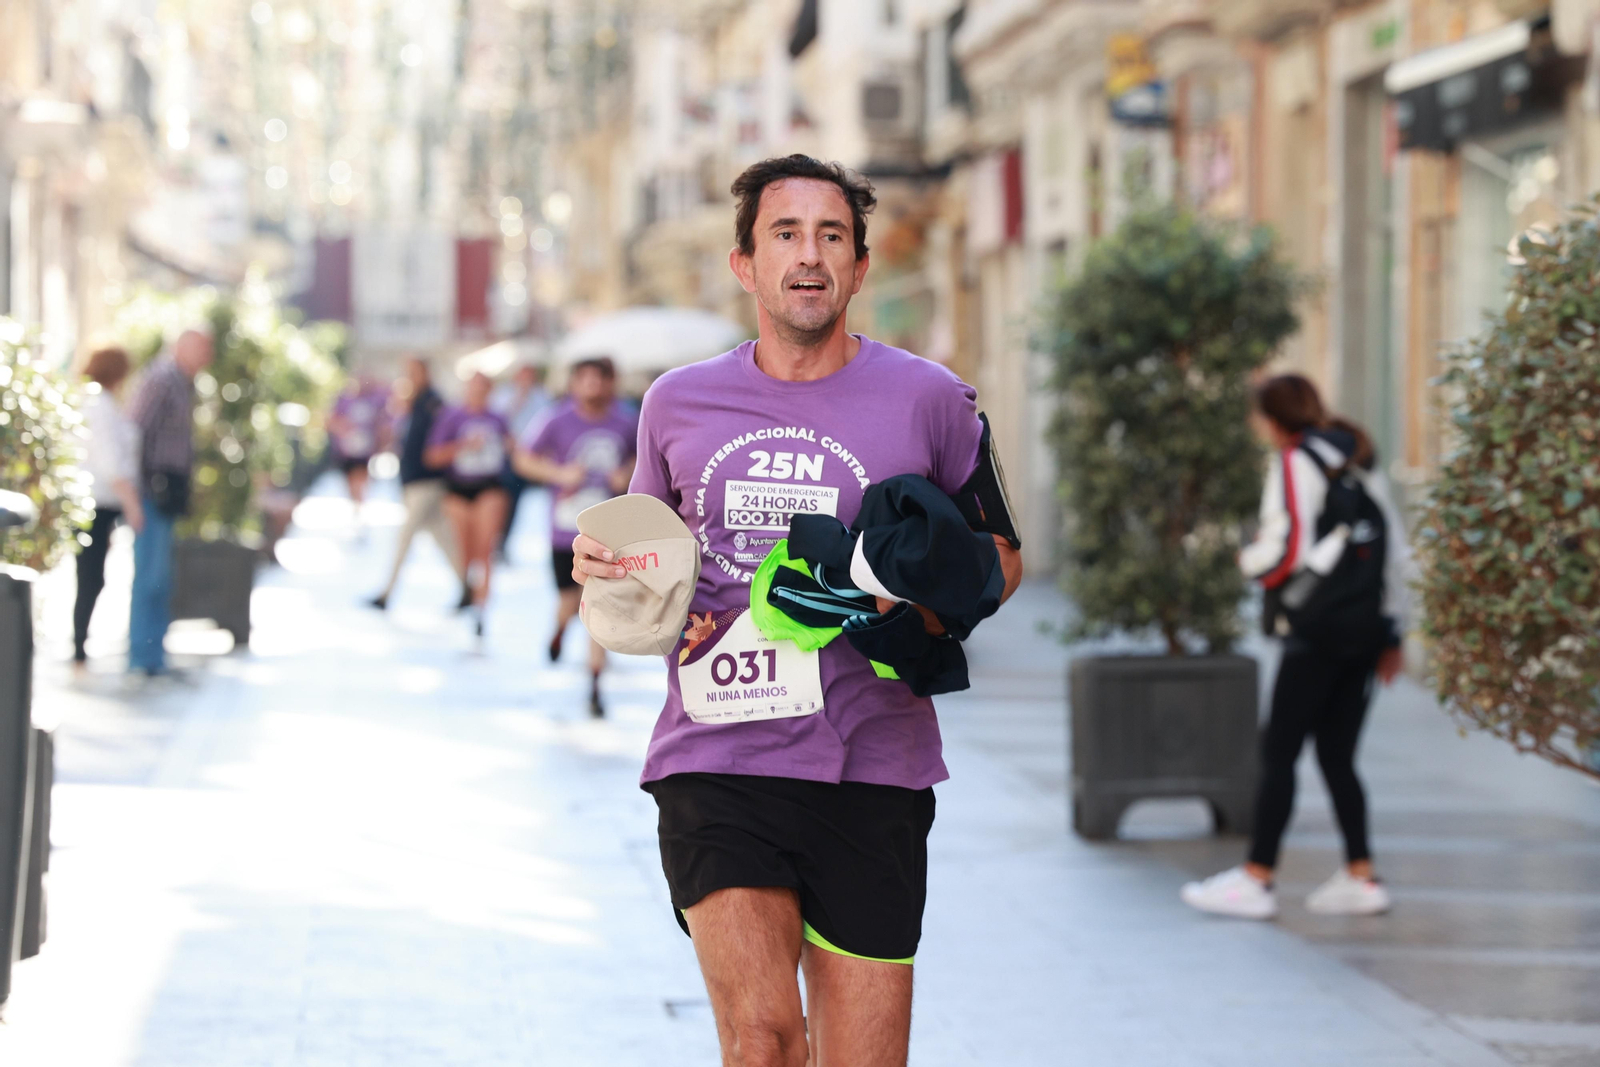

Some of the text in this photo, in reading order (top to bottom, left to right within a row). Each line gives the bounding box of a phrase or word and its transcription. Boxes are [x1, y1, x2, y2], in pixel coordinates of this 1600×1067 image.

[695, 426, 871, 517] DÍA INTERNACIONAL CONTRA
[747, 450, 825, 482] 25N
[729, 484, 766, 494] SERVICIO
[778, 488, 834, 499] EMERGENCIAS
[741, 494, 818, 512] 24 HORAS
[729, 510, 765, 526] 900
[767, 512, 783, 526] 21
[711, 649, 777, 687] 031
[706, 686, 788, 703] NI UNA MENOS
